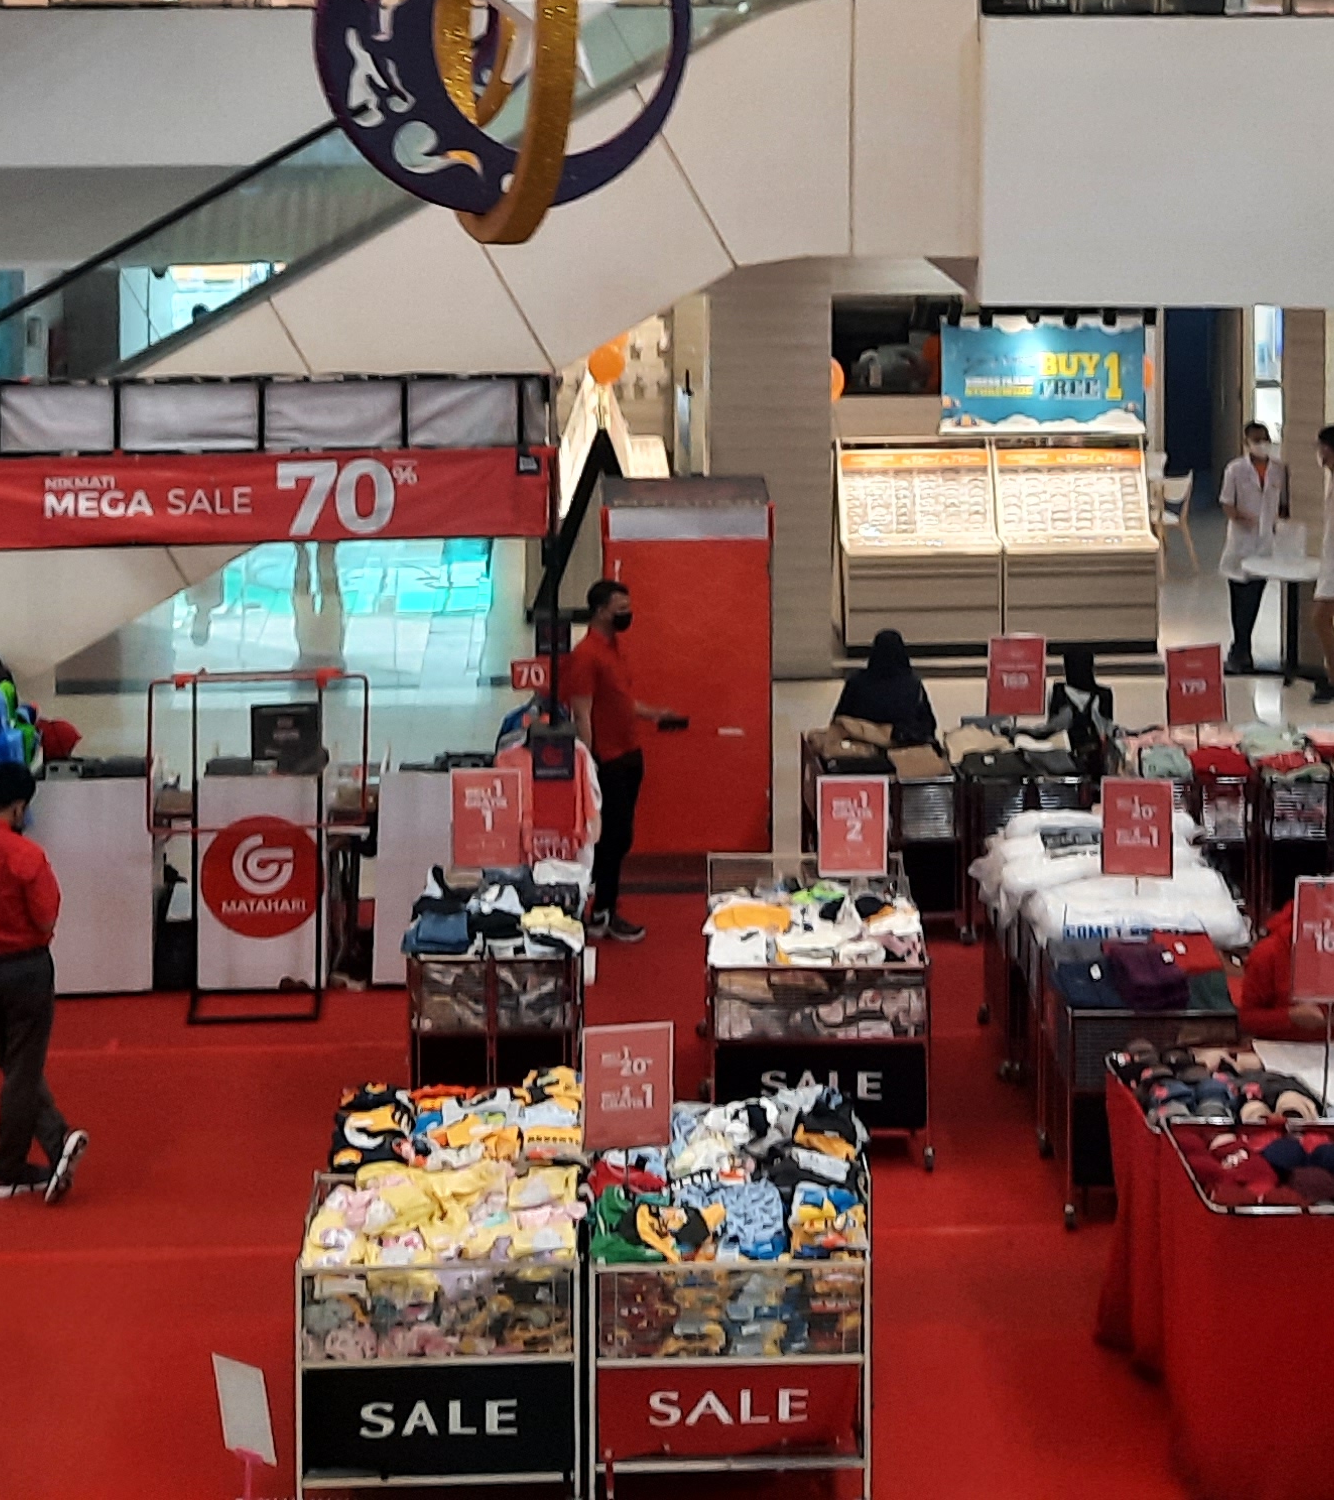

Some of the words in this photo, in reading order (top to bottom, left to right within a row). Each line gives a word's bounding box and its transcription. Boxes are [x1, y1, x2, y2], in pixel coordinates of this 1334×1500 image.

[1039, 378, 1101, 400] FREE
[1103, 352, 1124, 402] 1
[1040, 352, 1101, 377] BUY
[44, 489, 154, 519] MEGA
[167, 486, 253, 515] SALE
[221, 898, 306, 914] MATAHARI
[359, 1399, 519, 1440] SALE
[648, 1387, 810, 1429] SALE
